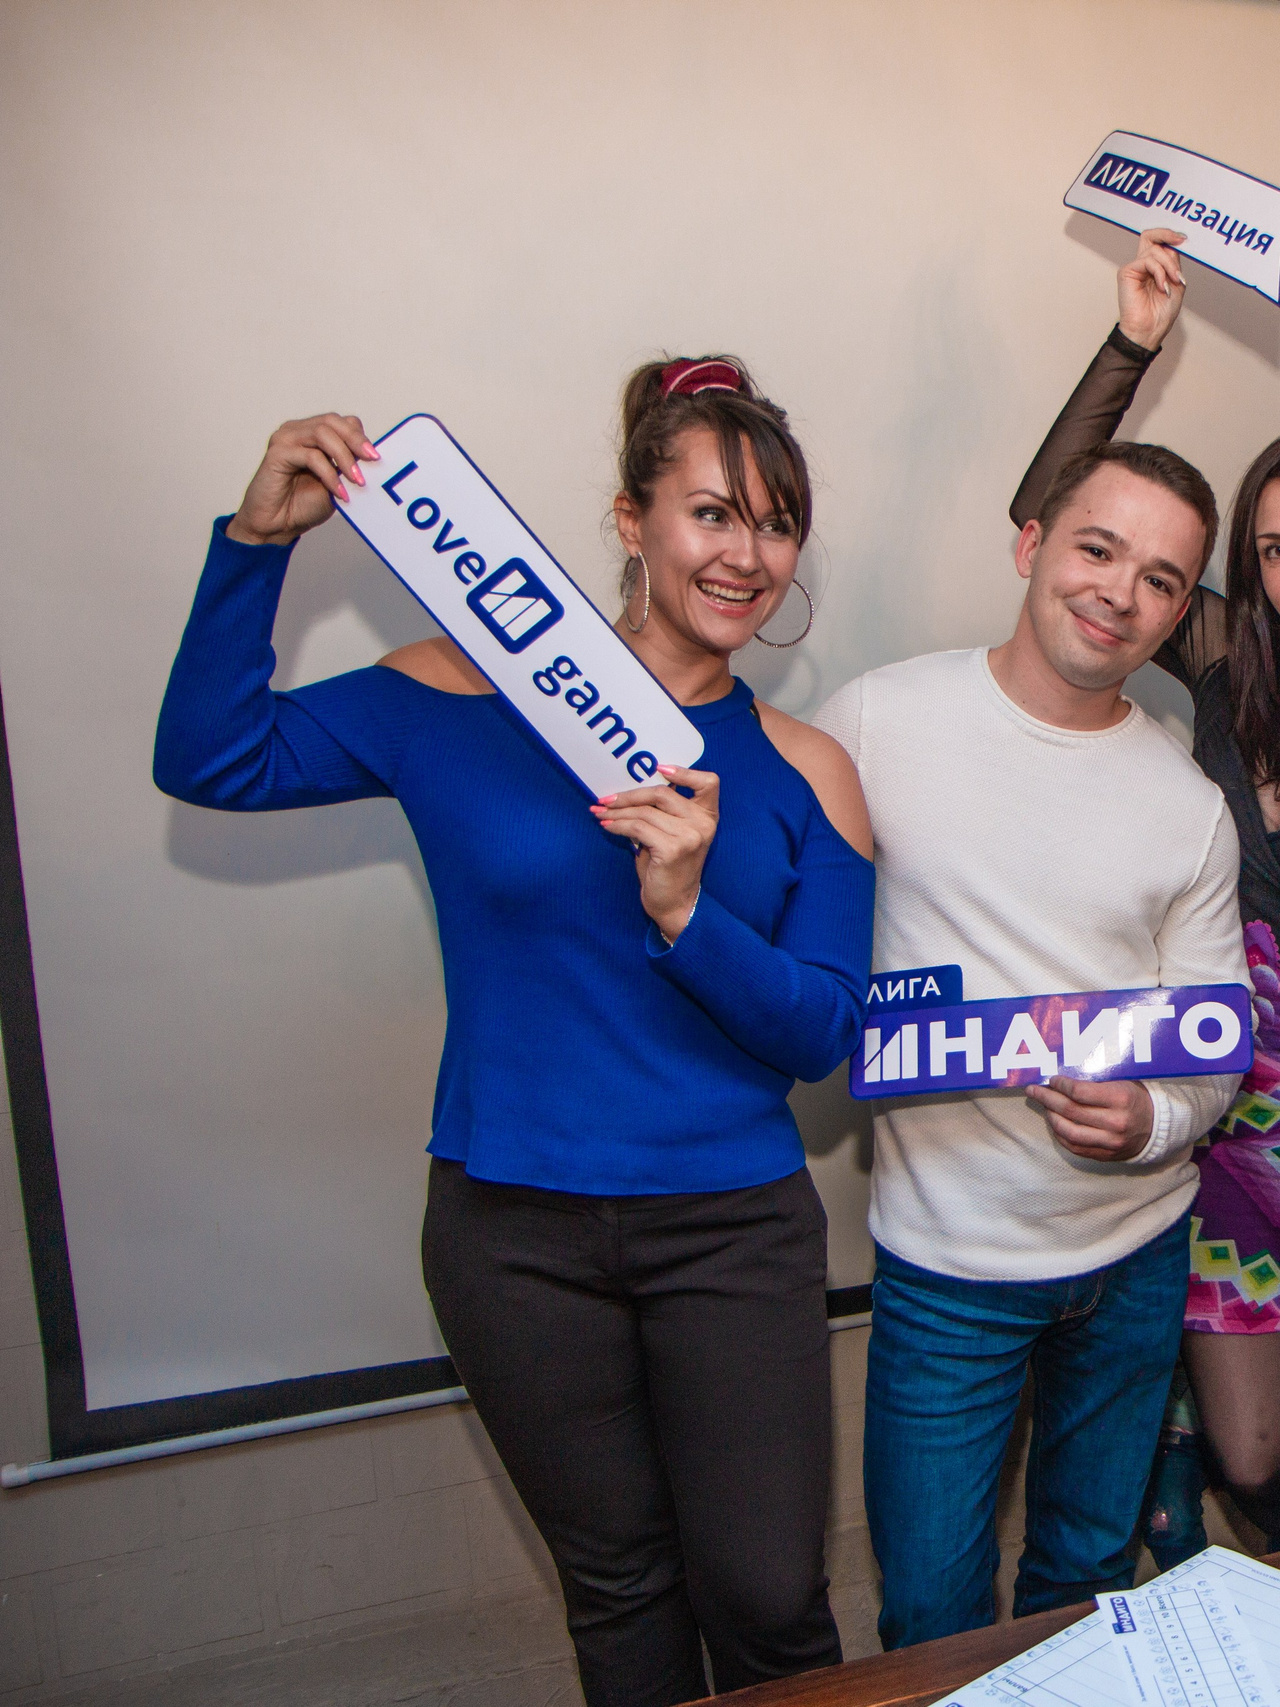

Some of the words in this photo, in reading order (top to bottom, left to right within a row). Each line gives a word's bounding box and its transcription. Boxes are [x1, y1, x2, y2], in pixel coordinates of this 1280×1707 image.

[381, 460, 488, 586] Love
[532, 655, 659, 784] game
[866, 975, 942, 1004] ЛИГА
[864, 1001, 1241, 1083] ИНДИГО
